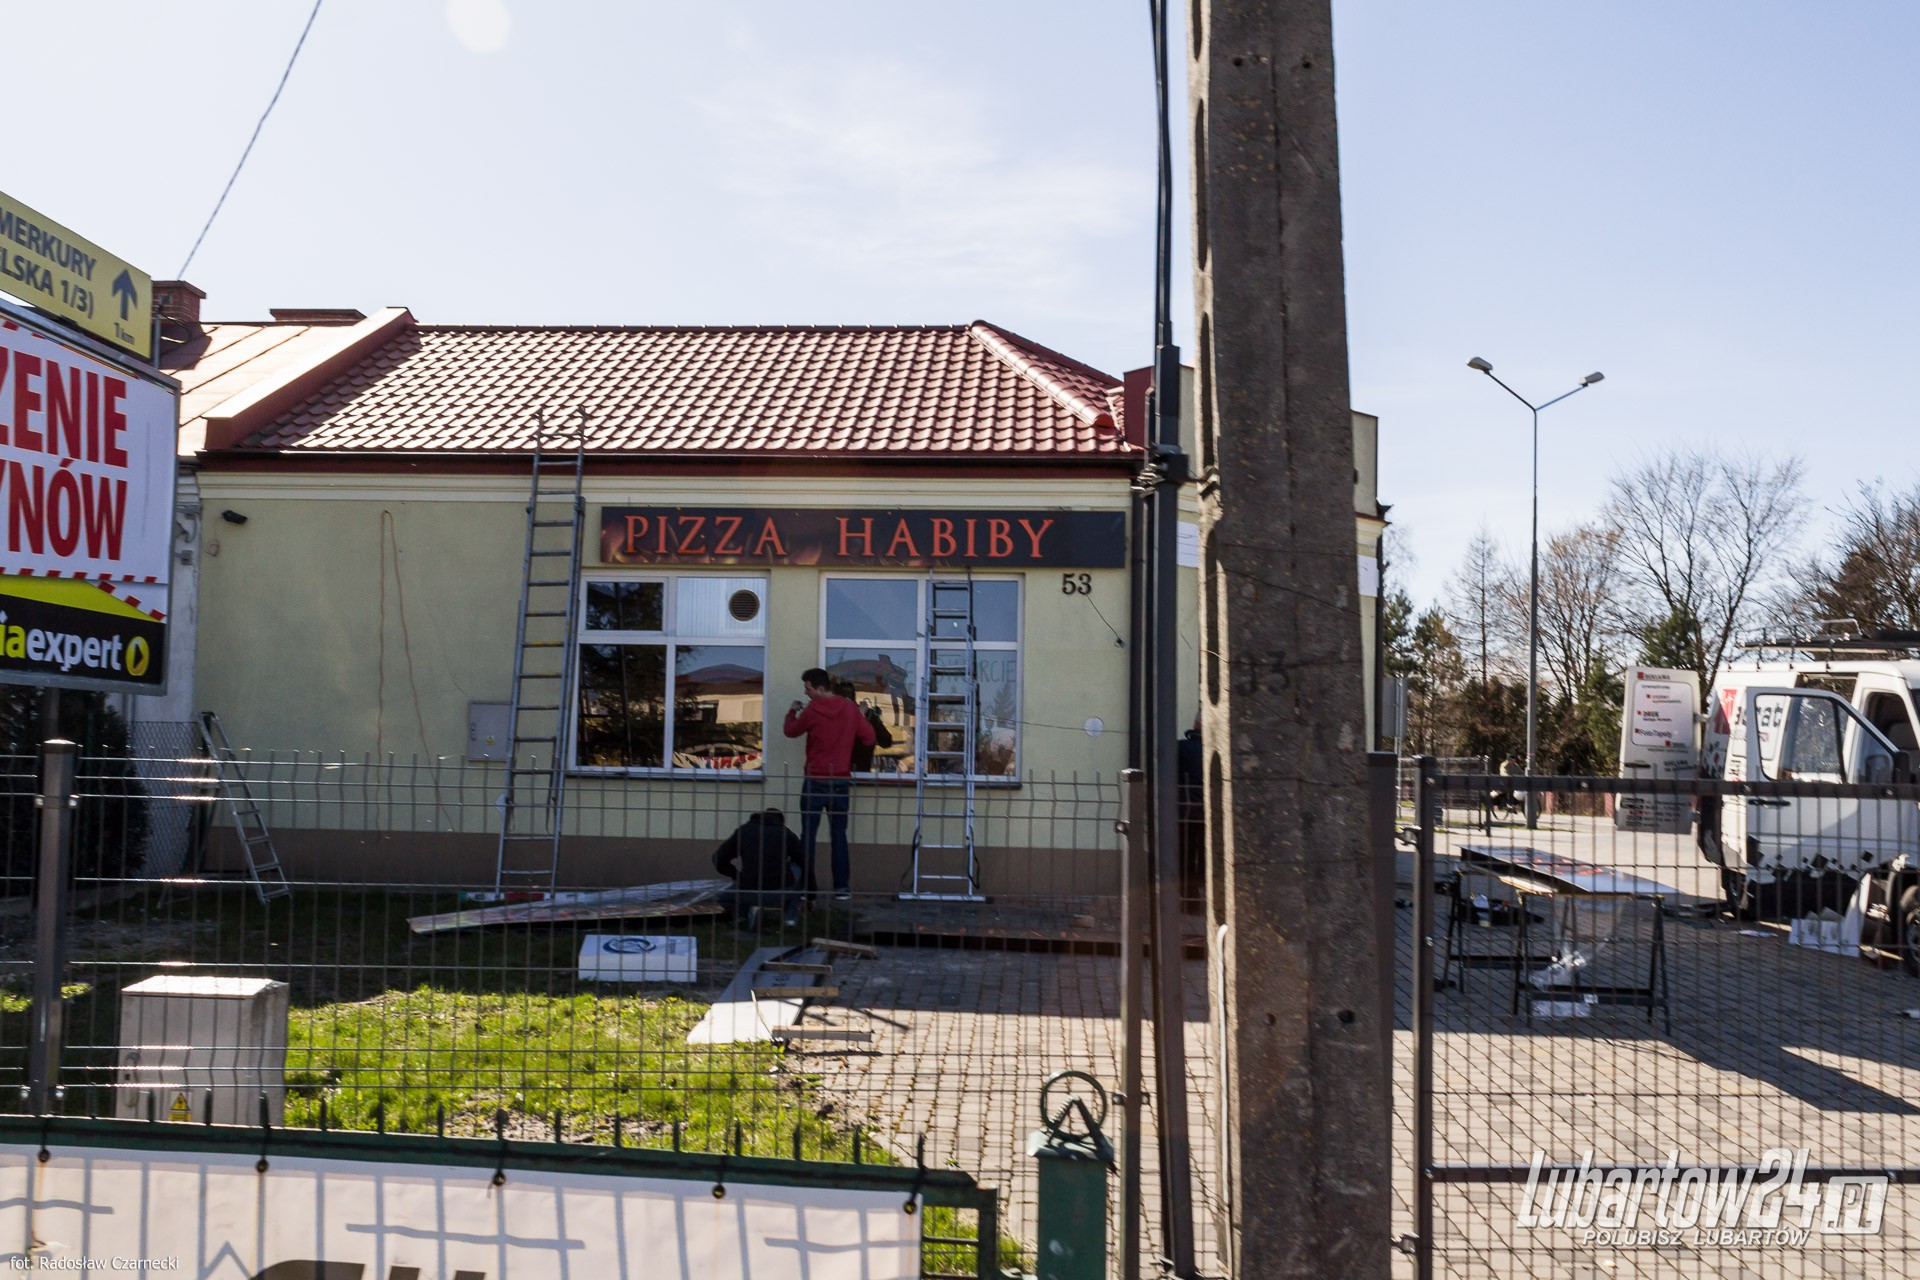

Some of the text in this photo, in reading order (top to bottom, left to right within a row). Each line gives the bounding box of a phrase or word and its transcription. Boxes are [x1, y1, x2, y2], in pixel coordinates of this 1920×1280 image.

[60, 280, 94, 320] 1/3)
[114, 321, 121, 338] 1
[0, 457, 128, 561] NÓW
[624, 515, 1055, 558] PIZZA HABIBY
[1061, 572, 1093, 596] 53
